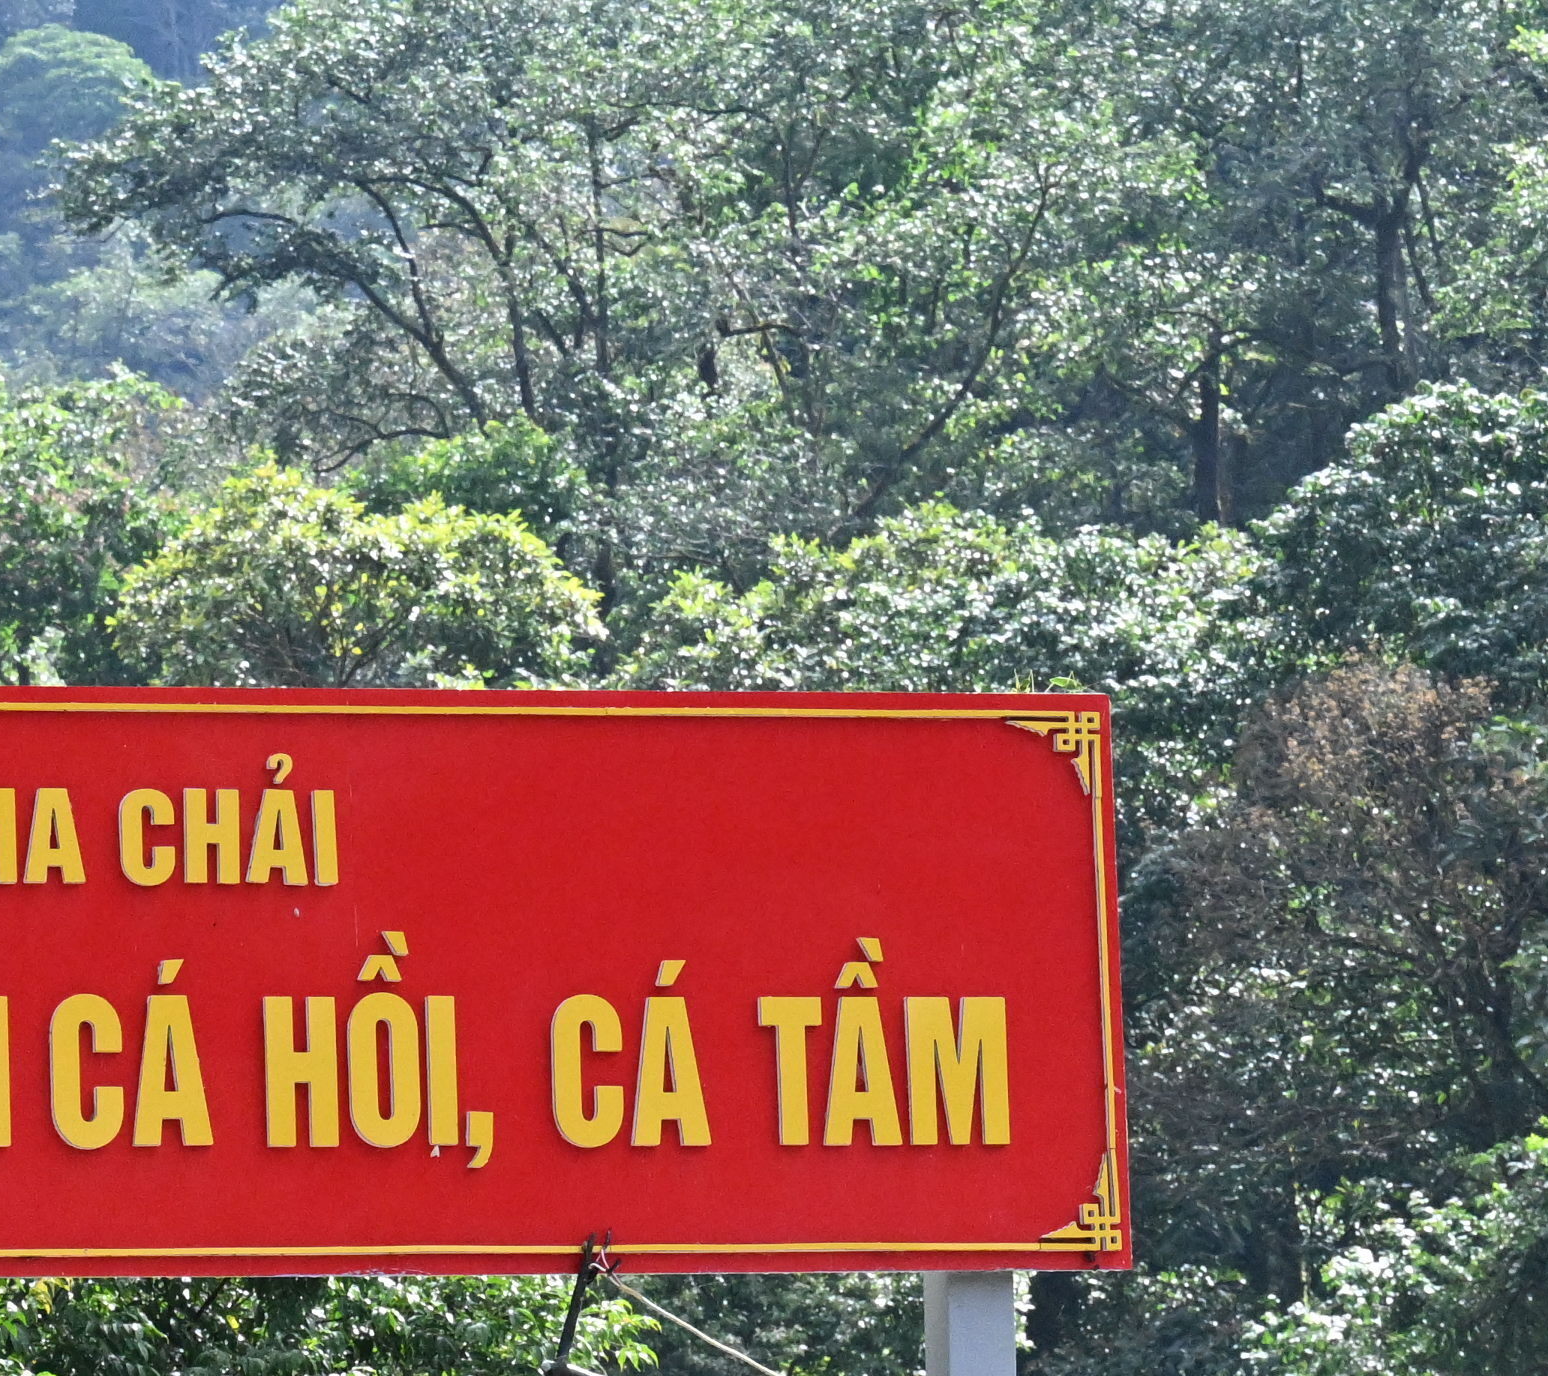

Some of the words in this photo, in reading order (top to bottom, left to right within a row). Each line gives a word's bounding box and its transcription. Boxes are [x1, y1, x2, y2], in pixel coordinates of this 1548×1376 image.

[119, 752, 340, 887] CHẢI
[50, 958, 215, 1150] CÁ
[263, 930, 496, 1169] HỒI,
[552, 958, 713, 1149] CÁ
[758, 936, 1012, 1147] TẦM
